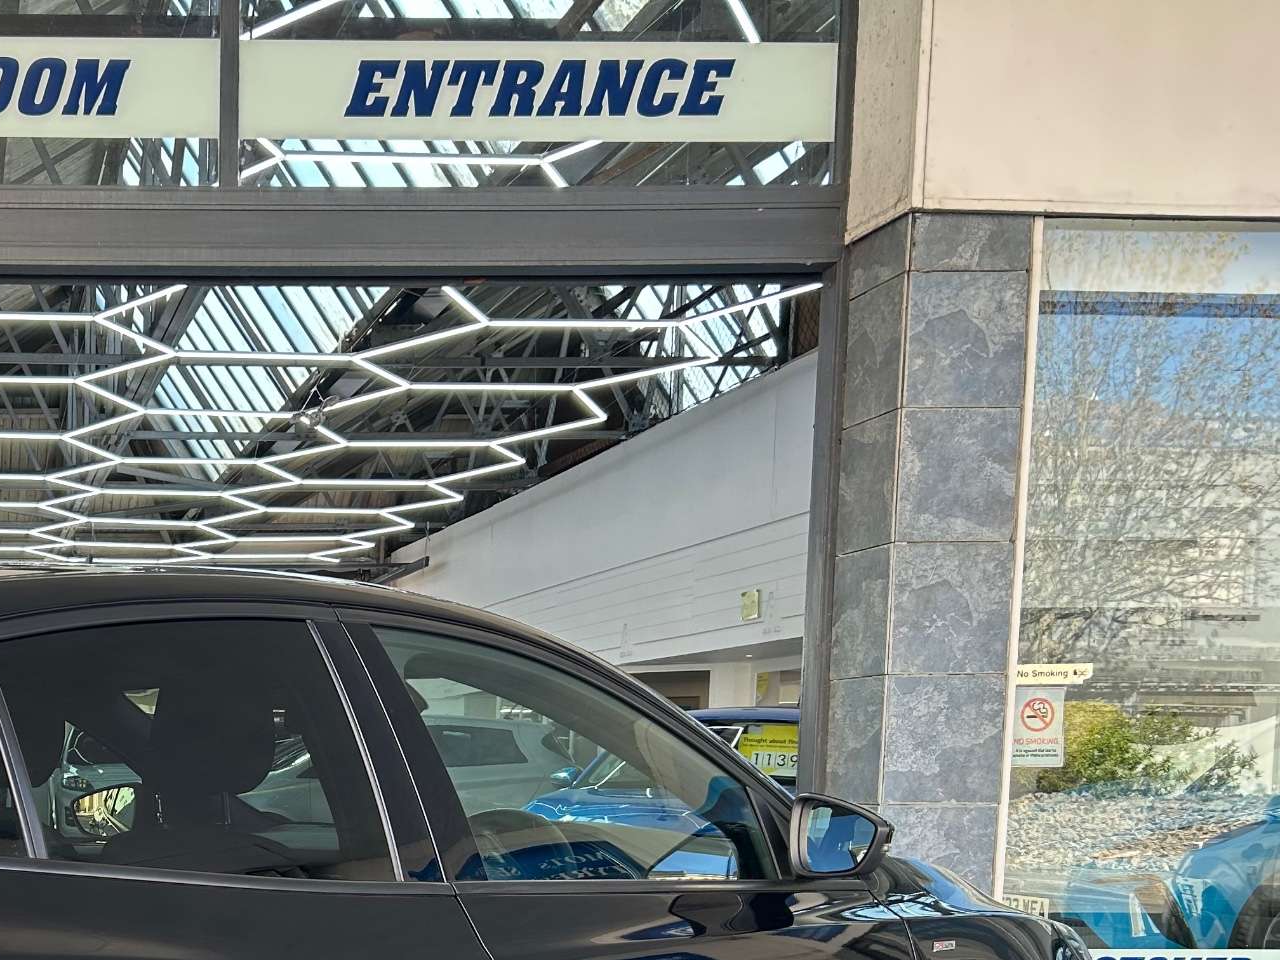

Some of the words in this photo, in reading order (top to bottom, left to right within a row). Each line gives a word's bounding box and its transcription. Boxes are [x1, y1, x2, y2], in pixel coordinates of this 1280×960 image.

[342, 58, 736, 118] ENTRANCE
[1017, 669, 1029, 678] No
[1031, 668, 1069, 679] Smoking
